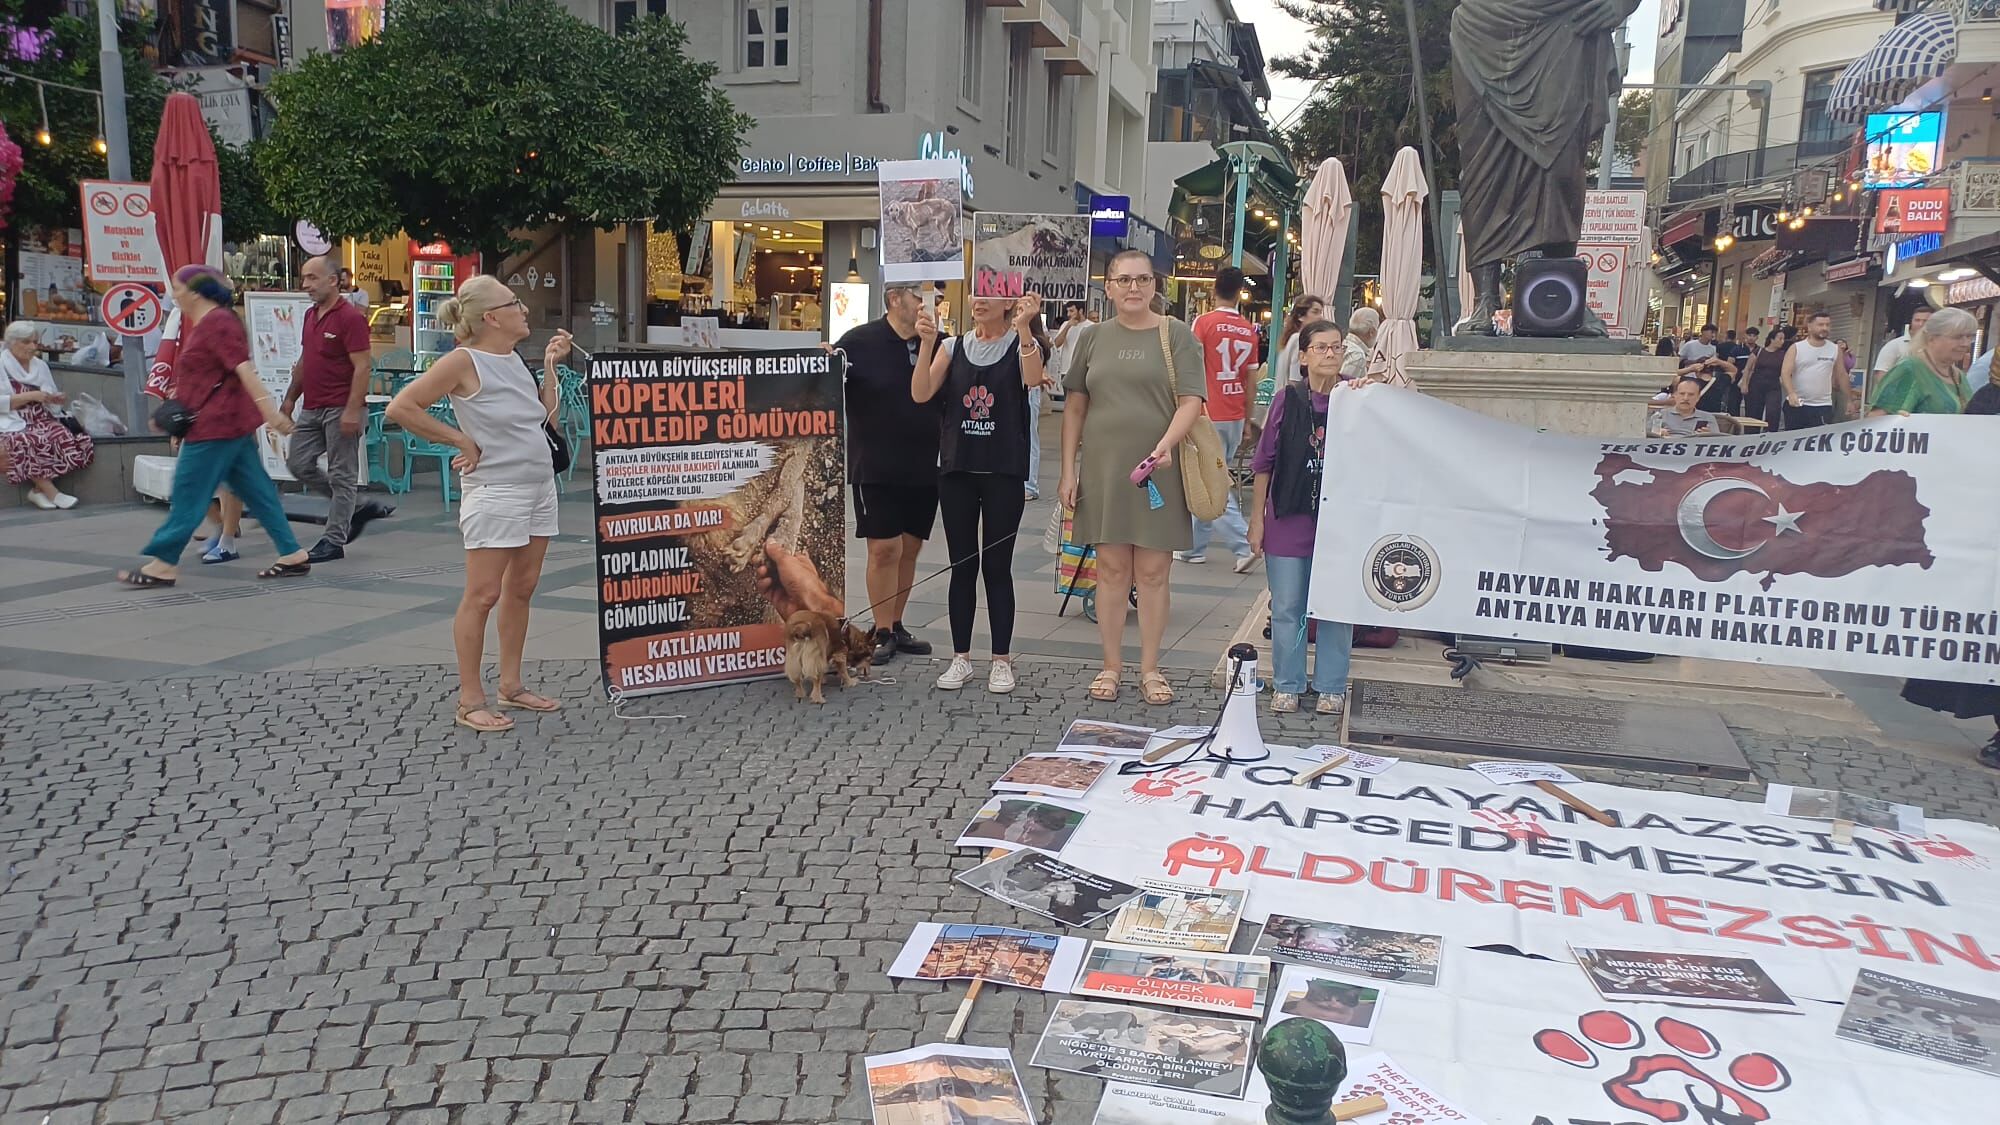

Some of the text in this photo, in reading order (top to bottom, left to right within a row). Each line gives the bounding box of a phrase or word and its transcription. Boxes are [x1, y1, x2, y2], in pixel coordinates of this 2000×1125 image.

[741, 156, 785, 173] Gelato
[796, 156, 843, 173] Coffee
[1907, 211, 1943, 222] BALIK
[1909, 200, 1943, 210] DUDU
[360, 261, 384, 274] Away
[361, 250, 380, 260] Take
[977, 270, 1023, 297] KAN
[591, 352, 830, 380] ANTALYA BÜYÜKŞEHİR BELEDİYESİ
[1215, 337, 1253, 381] 17
[592, 375, 746, 414] KÖPEKLERİ
[594, 407, 836, 445] KATLEDİP GÖMÜYOR!
[961, 419, 996, 431] ATTALOS
[605, 446, 758, 465] ANTALYA BÜYÜKŞEHİR BELEDİYESİ'NE AİT
[1600, 427, 1930, 458] TEK SES TEK GÜÇ TEK ÇÖZÜM
[607, 470, 736, 488] YÜZLERCE KÖPEĞİN CANSIZ BEDENİ
[651, 462, 682, 474] HAYVAN
[722, 459, 760, 471] ALANINDA
[607, 484, 705, 500] ARKADAŞLARIMIZ BULDU.
[606, 509, 723, 538] YAVRULAR DA VAR!
[602, 546, 693, 576] TOPLADINIZ.
[603, 572, 705, 603] ÖLDÜRDÜNÜZ.
[604, 600, 691, 630] GÖMDÜNÜZ.
[1477, 570, 1999, 636] HAYVAN HAKLARI PLATFORMU TÜRKİ
[1475, 597, 1587, 627] ANTALYA
[1594, 609, 1702, 638] HAYVAN
[1710, 619, 1839, 651] HAKLARI
[647, 631, 740, 660] KATLİAMIN
[621, 657, 701, 687] HESABINI
[1100, 983, 1236, 1008] İSTEMİYORUM
[1136, 977, 1204, 994] ÖLMEK
[1863, 972, 1946, 996] GLOBAL CALL
[1059, 1038, 1117, 1054] NİĞDE'DE
[1129, 1049, 1184, 1064] BACAKLI
[1185, 1058, 1233, 1071] ANNEYİ
[1068, 1048, 1221, 1077] YAVRULARIYLA BİRLİKTE
[1095, 1059, 1185, 1080] ÖLDÜRDÜLER!
[1163, 1095, 1196, 1107] CALL
[1367, 1073, 1437, 1117] PROPERTY
[1377, 1062, 1467, 1121] THEY ARE NOT
